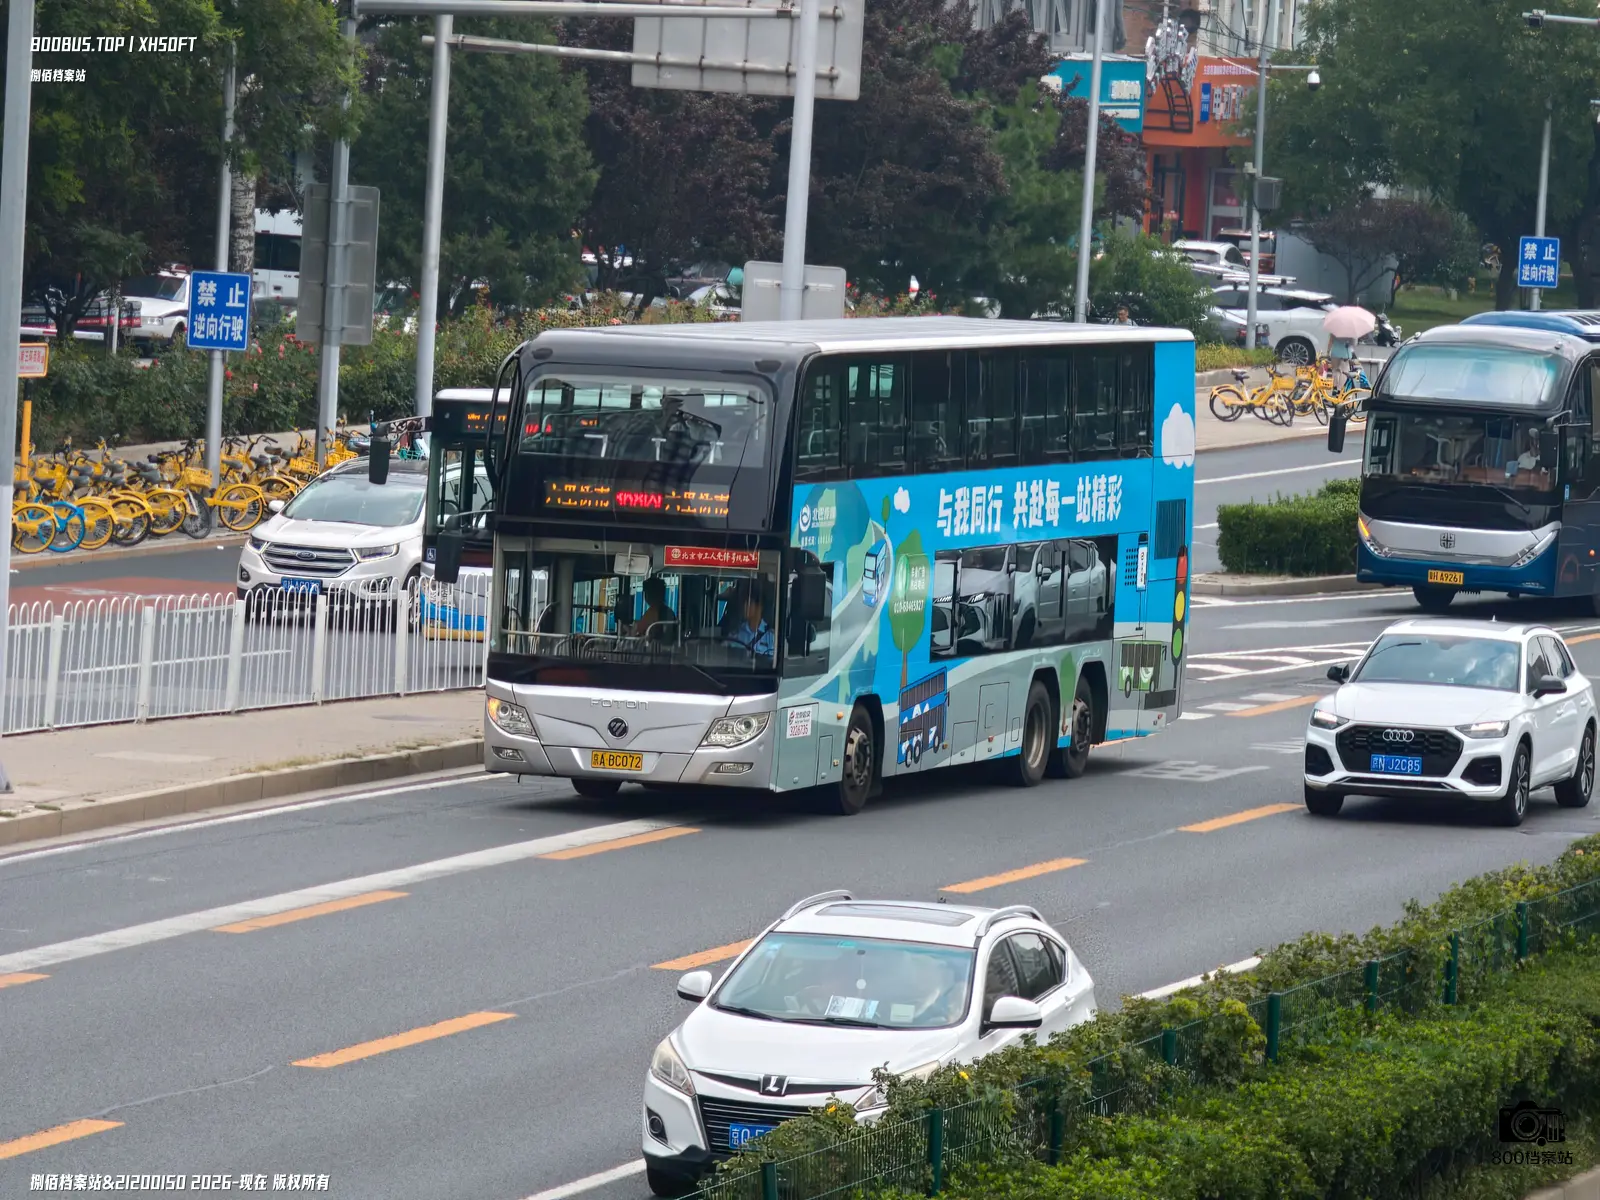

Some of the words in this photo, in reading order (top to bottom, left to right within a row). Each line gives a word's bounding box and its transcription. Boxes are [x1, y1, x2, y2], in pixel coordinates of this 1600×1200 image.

[1521, 263, 1555, 282] 逆向行驶
[192, 313, 244, 342] 逆向行驶
[936, 484, 1003, 537] 与我同行
[1013, 474, 1123, 530] 共赴每一站精彩
[1387, 758, 1420, 772] J2C85
